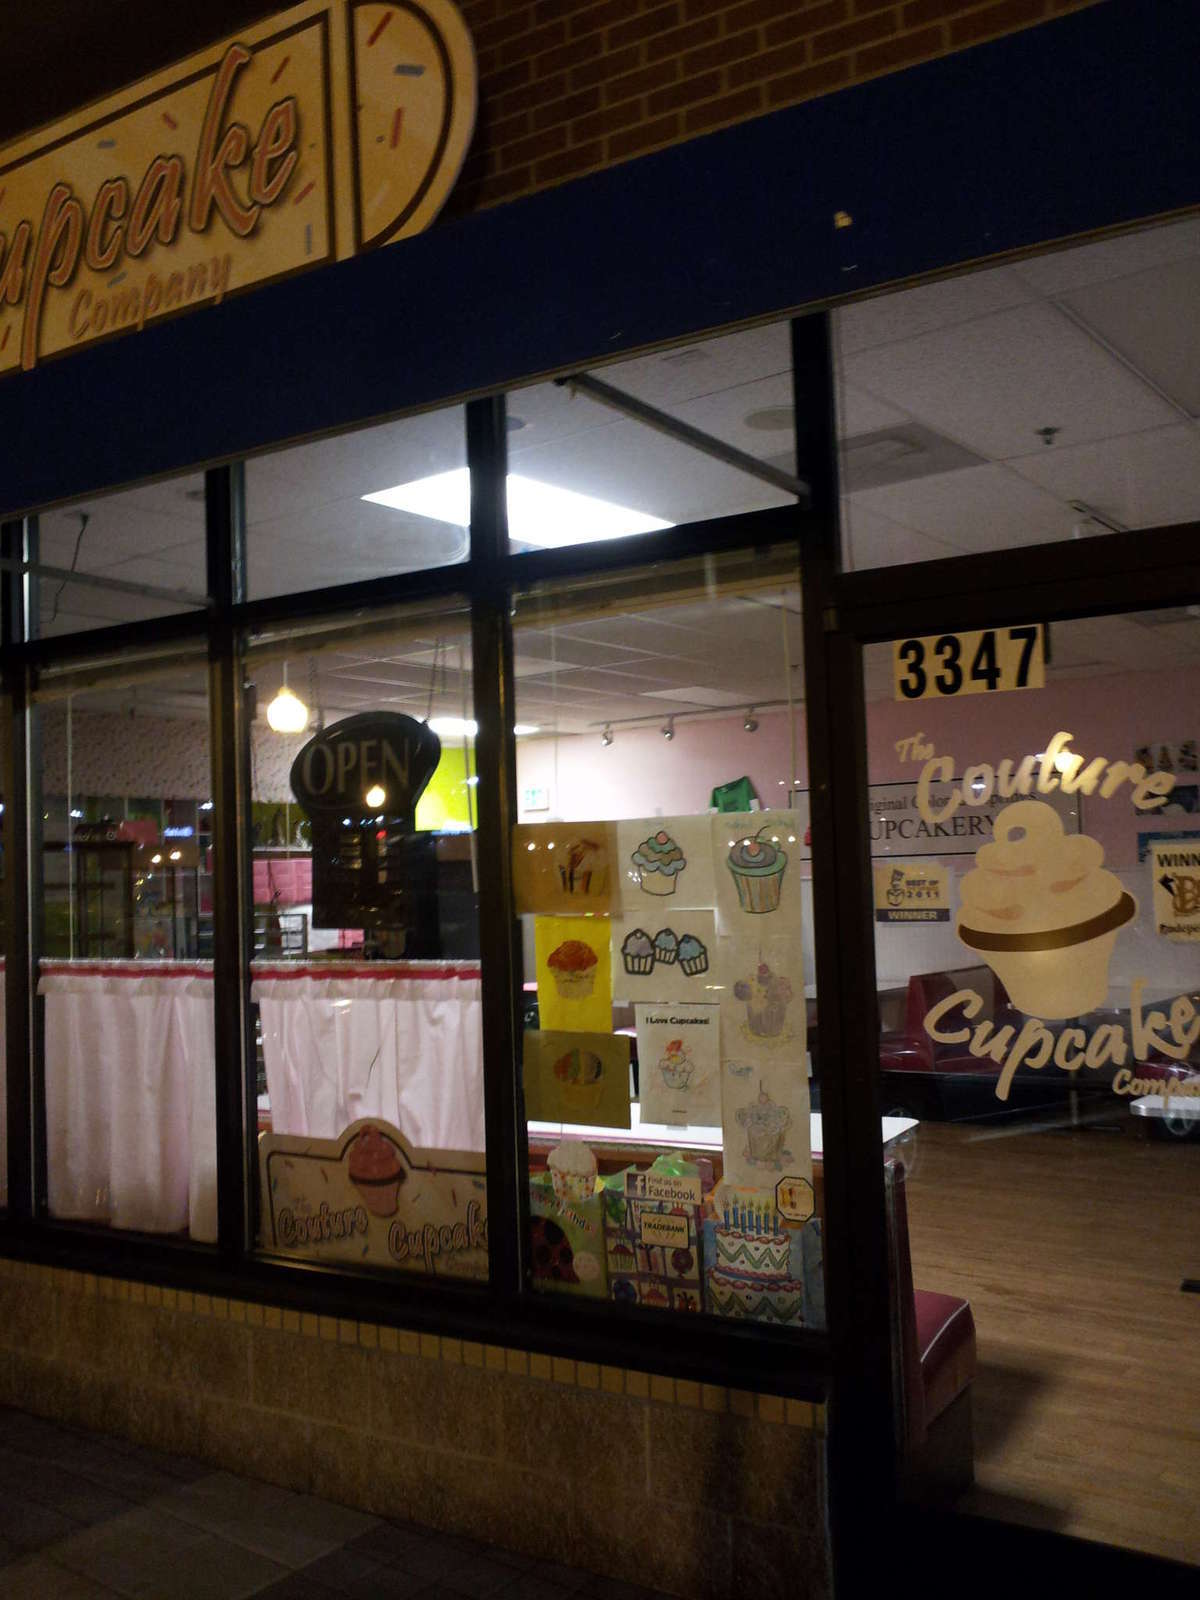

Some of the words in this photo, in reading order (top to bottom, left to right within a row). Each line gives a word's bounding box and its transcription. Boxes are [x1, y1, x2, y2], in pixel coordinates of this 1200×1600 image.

[68, 253, 232, 338] Company
[899, 626, 1037, 698] 3347
[302, 737, 411, 796] OPEN
[896, 732, 935, 762] The
[917, 731, 1176, 824] Couture
[888, 911, 937, 920] WINNER
[923, 978, 1200, 1101] Cupcake
[649, 1186, 695, 1201] Facebook
[278, 1202, 368, 1247] Couture
